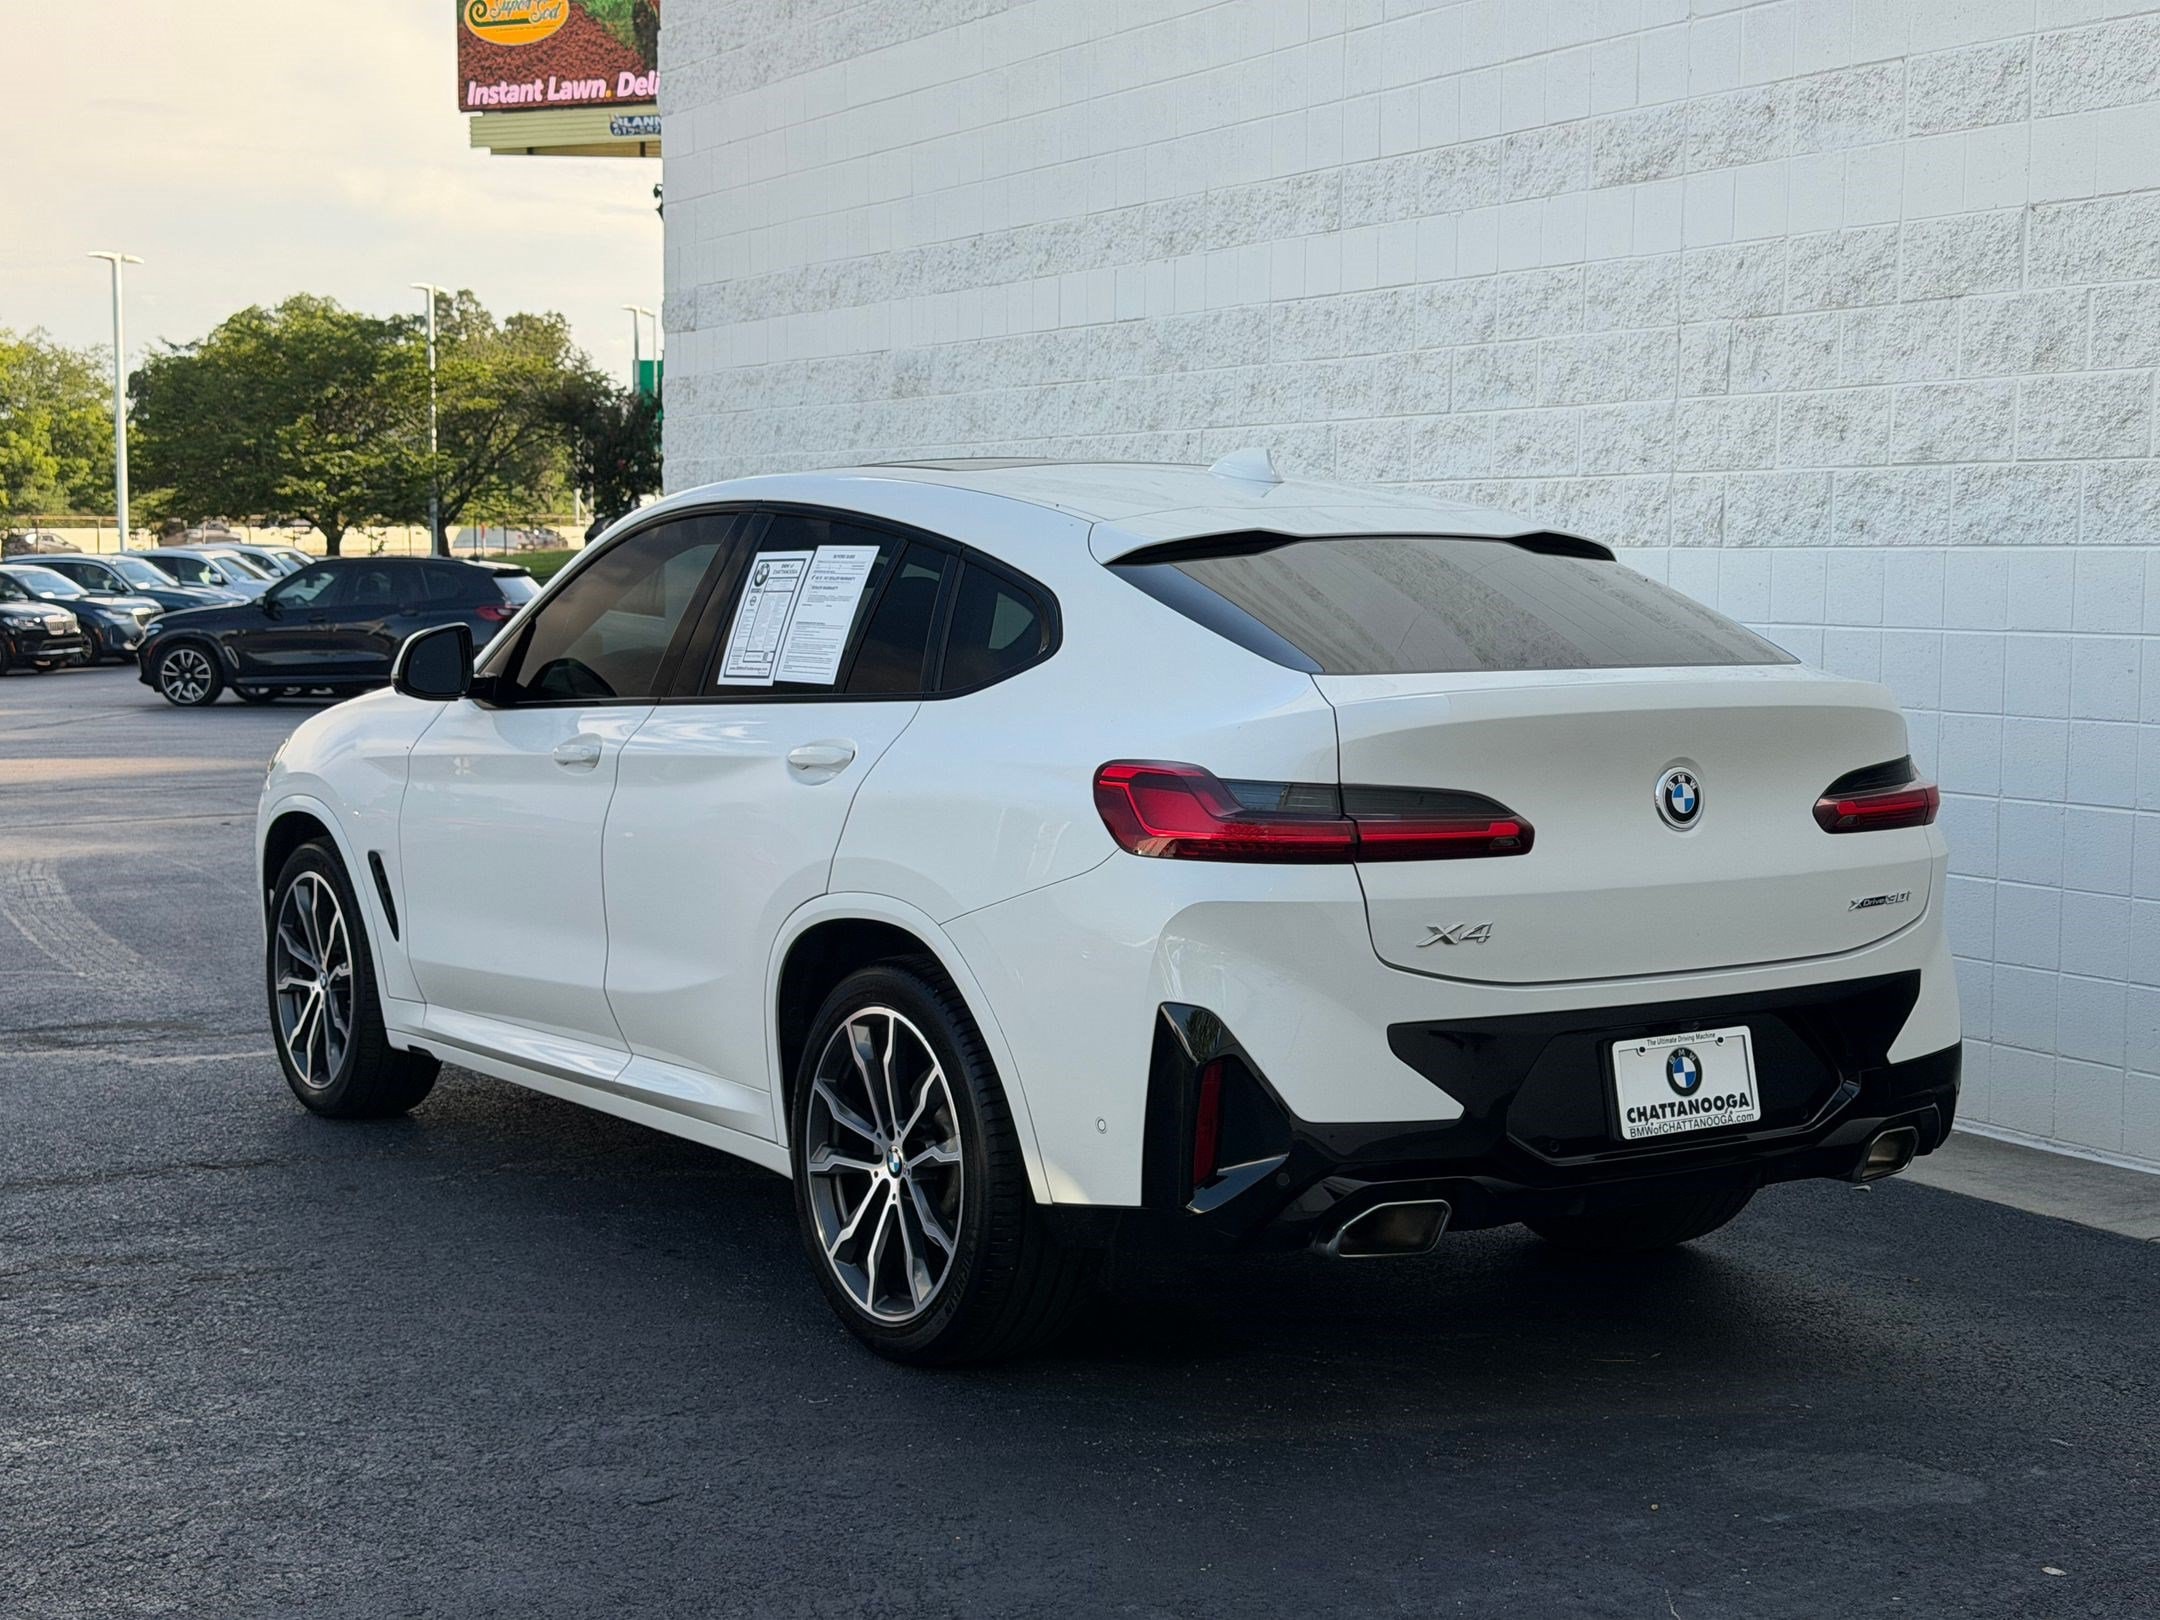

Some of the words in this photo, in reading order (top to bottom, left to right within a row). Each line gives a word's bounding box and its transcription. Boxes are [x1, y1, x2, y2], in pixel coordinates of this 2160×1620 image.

[467, 78, 545, 106] Instant
[547, 76, 611, 101] Lawn.
[1666, 774, 1698, 791] BMW
[1416, 921, 1493, 947] X4
[1657, 1035, 1677, 1045] Ultimate
[1678, 1034, 1695, 1043] Driving
[1696, 1032, 1716, 1040] Machine
[1669, 1049, 1697, 1065] BMW
[1626, 1092, 1750, 1124] CHATTANOOGA
[1630, 1112, 1754, 1138] BMWofCHATTANOOGA.com
